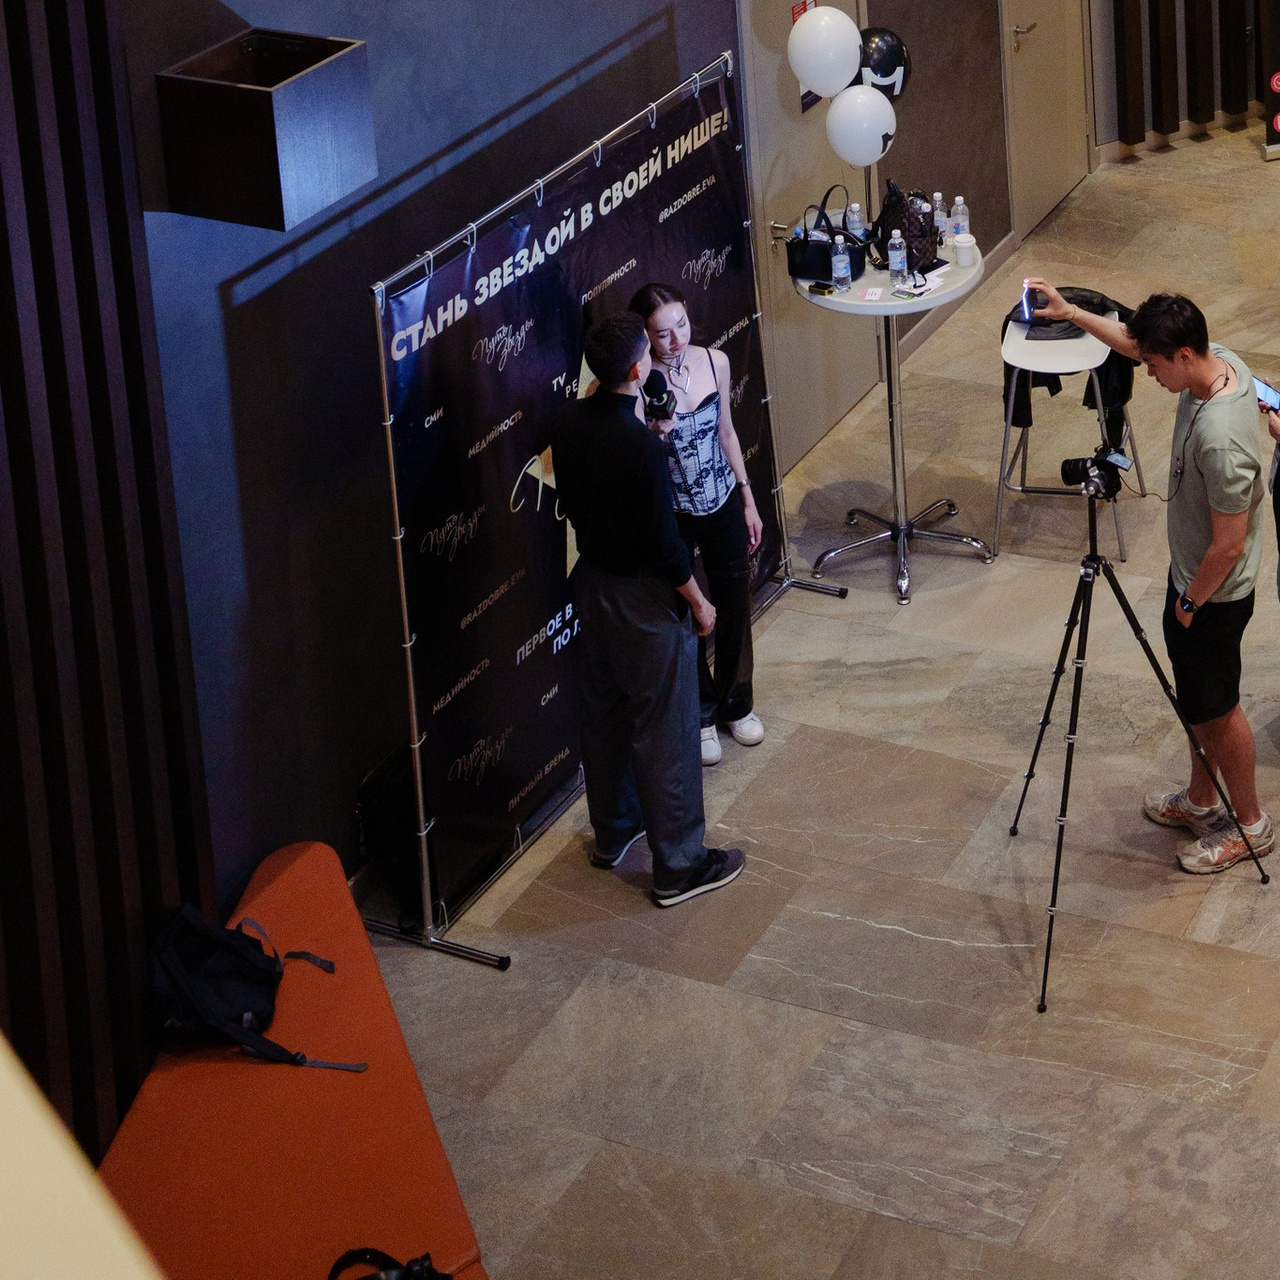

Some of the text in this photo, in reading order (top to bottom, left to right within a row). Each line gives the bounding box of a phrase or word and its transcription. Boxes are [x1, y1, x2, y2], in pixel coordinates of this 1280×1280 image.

[659, 174, 716, 223] @RAZDOBRE.EVA
[391, 107, 728, 361] СТАНЬ ЗВЕЗДОЙ В СВОЕЙ НИШЕ!
[581, 258, 637, 305] ПОПУЛЯРНОСТЬ
[472, 323, 508, 364] Путь
[729, 316, 749, 339] БРЕНД
[552, 372, 566, 392] TV
[424, 407, 444, 428] СМИ
[468, 410, 523, 459] МЕДИЙНОСТЬ
[460, 568, 526, 629] @RAZDOBRE.EVA
[516, 611, 563, 665] ПЕРВОЕ
[565, 603, 573, 621] В
[553, 628, 570, 654] ПО
[432, 658, 491, 715] МЕДИЙНОСТЬ
[541, 683, 559, 706] СМИ
[508, 746, 571, 812] ЛИЧНЫЙ БРЕНД
